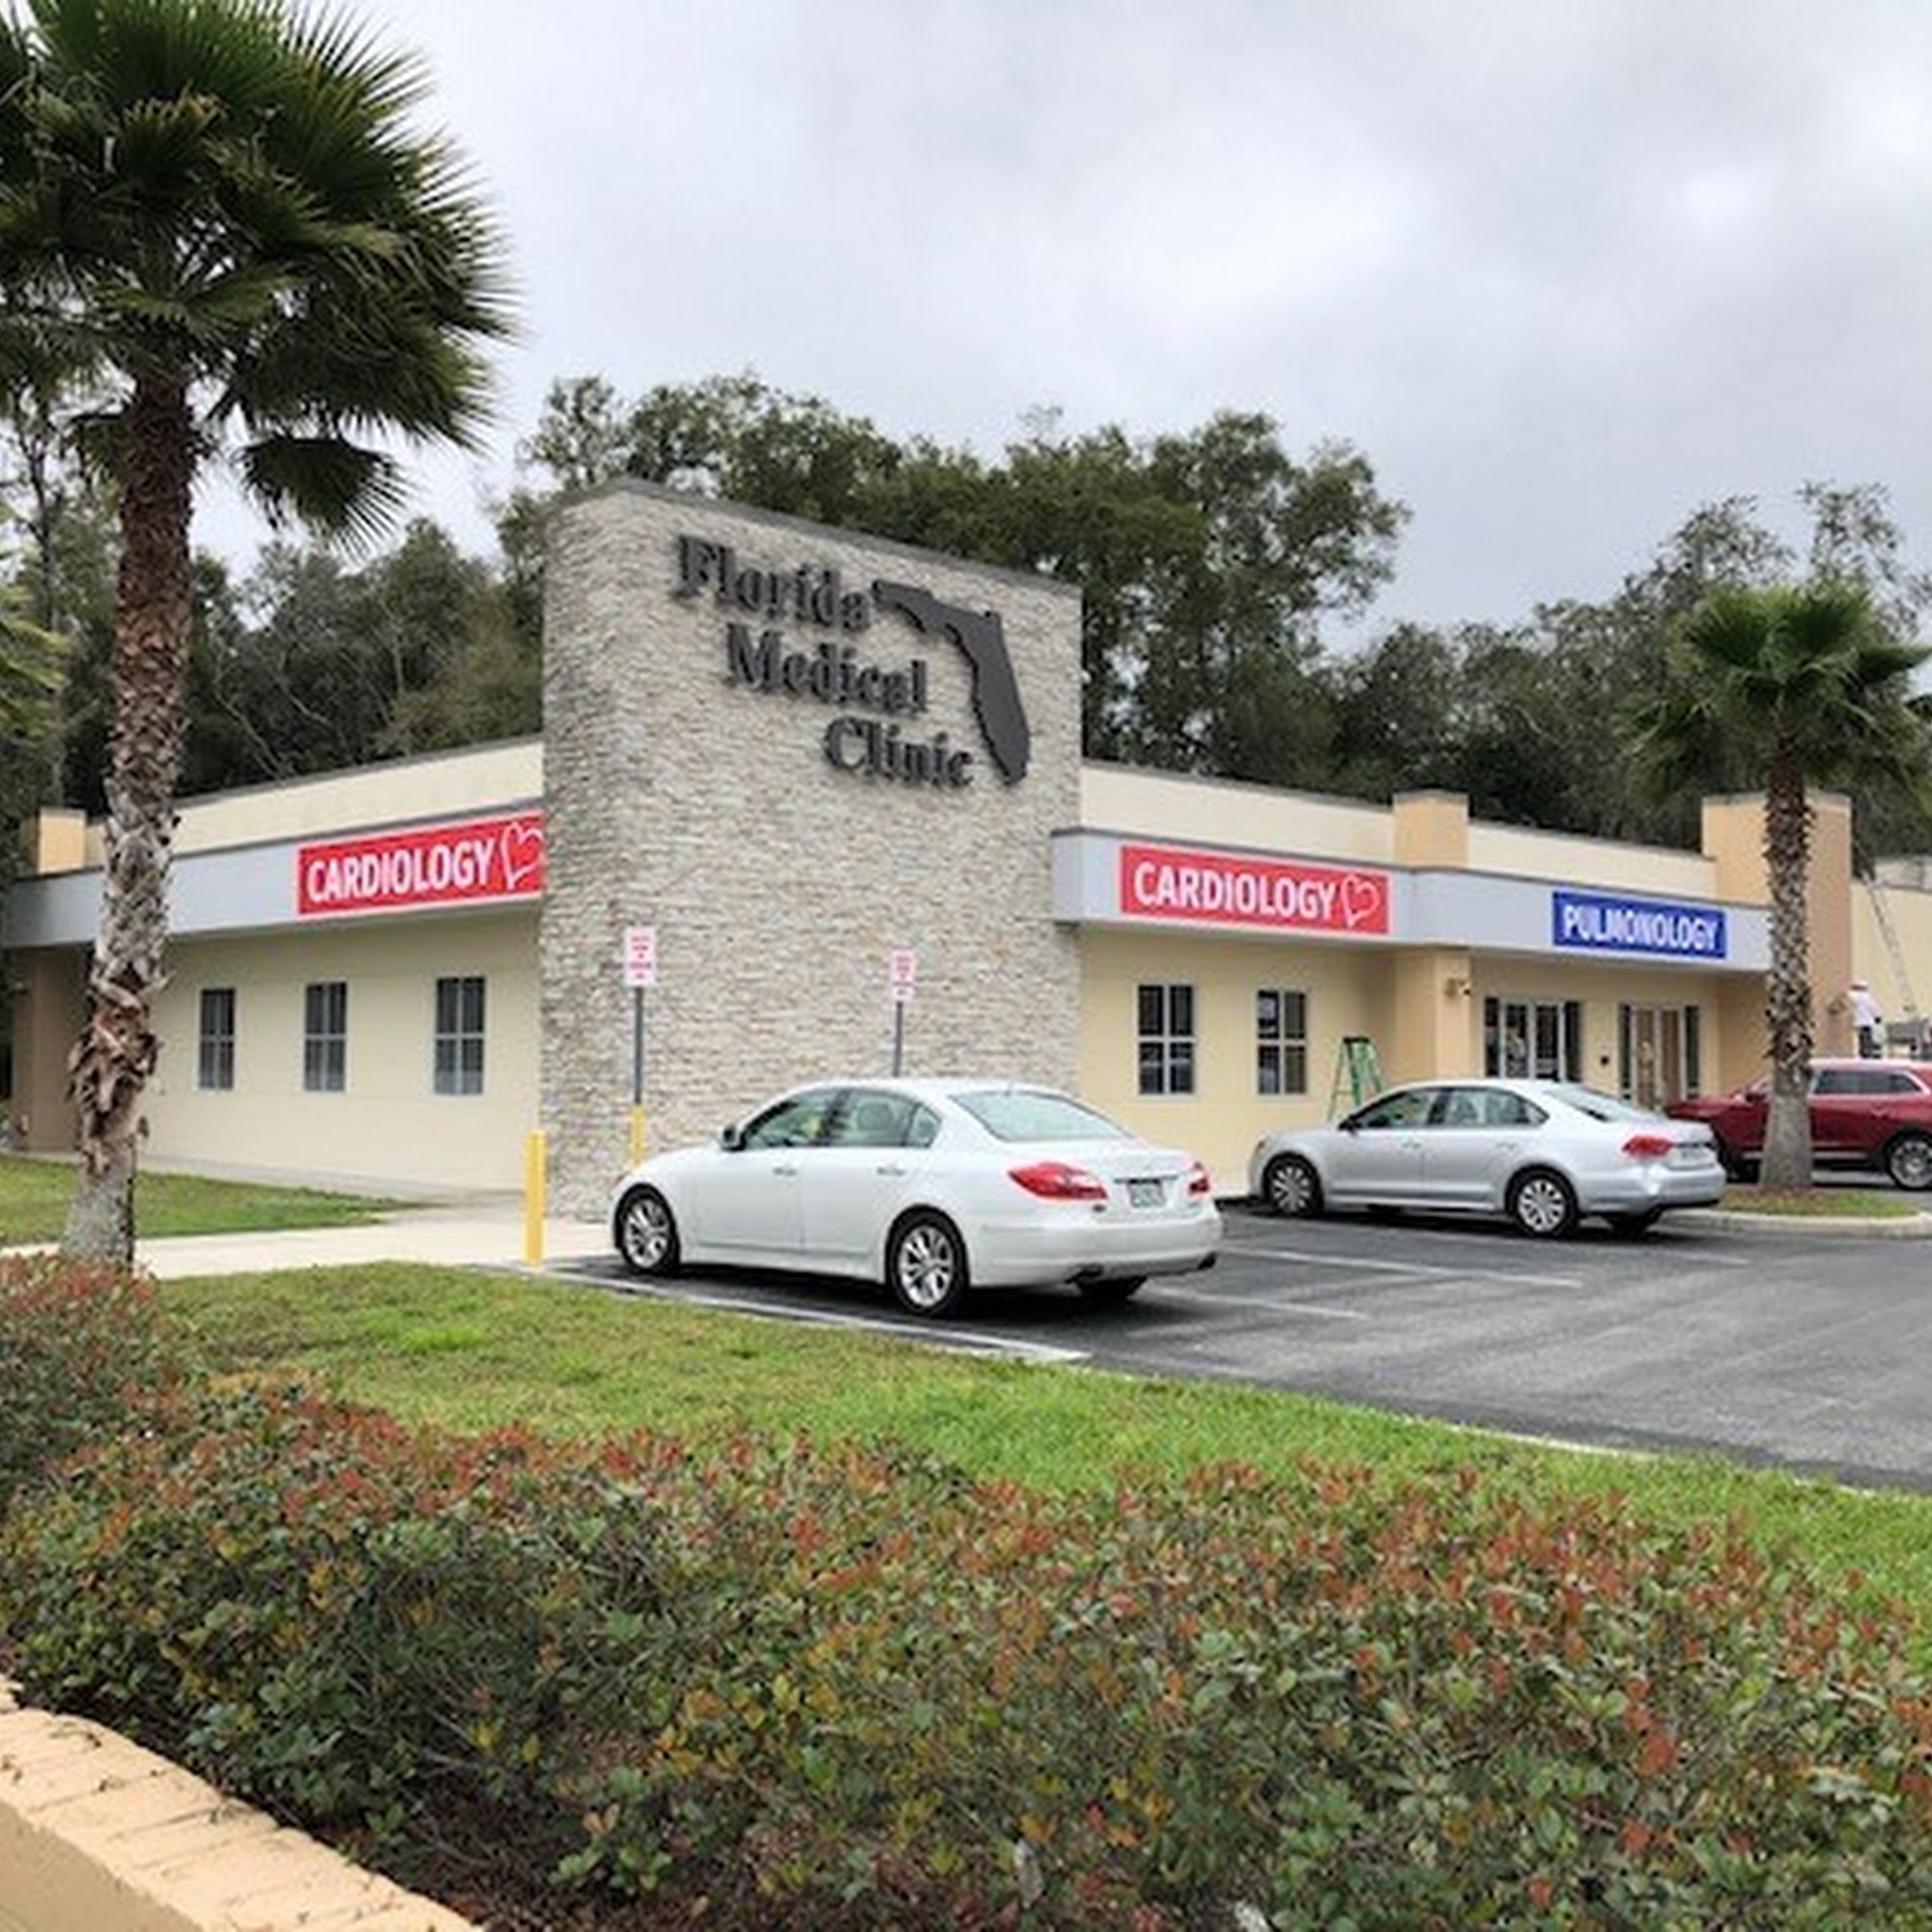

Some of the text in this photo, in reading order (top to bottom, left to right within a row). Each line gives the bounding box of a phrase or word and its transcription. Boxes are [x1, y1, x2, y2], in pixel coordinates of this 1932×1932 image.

[676, 535, 869, 632] Florida
[726, 623, 927, 714] Medical
[824, 717, 975, 788] Clinic
[307, 838, 495, 902] CARDIOLOGY
[1134, 863, 1336, 919] CARDIOLOGY
[1564, 905, 1719, 951] PULMONOLOGY
